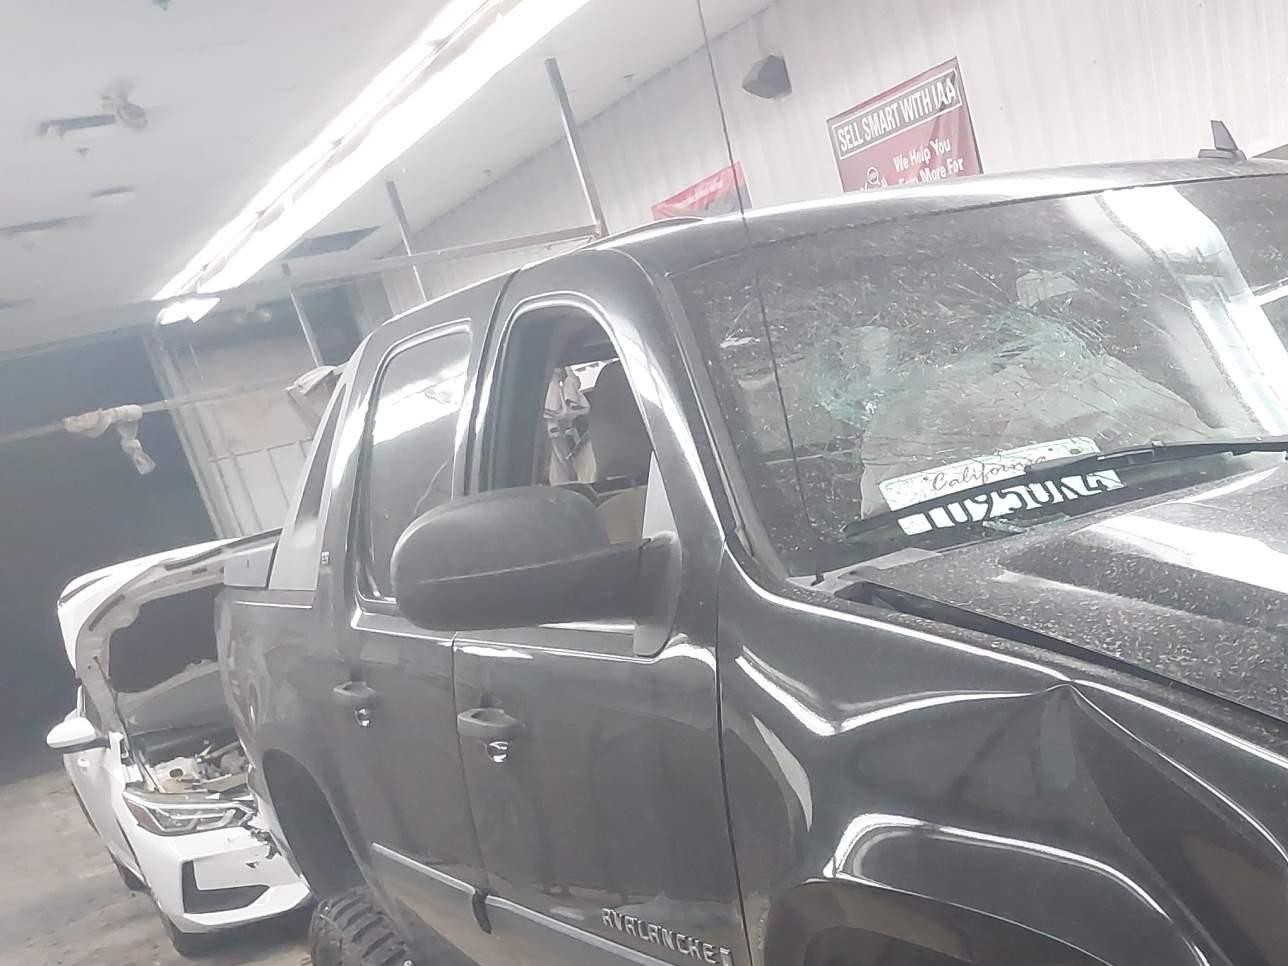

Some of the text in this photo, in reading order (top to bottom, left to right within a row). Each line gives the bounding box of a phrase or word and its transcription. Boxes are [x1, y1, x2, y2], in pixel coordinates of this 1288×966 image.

[838, 77, 957, 152] SELL SMART WITH IAA
[893, 138, 951, 173] We Help You
[919, 166, 946, 184] More
[947, 157, 964, 177] For
[601, 907, 718, 964] AVALANCHE
